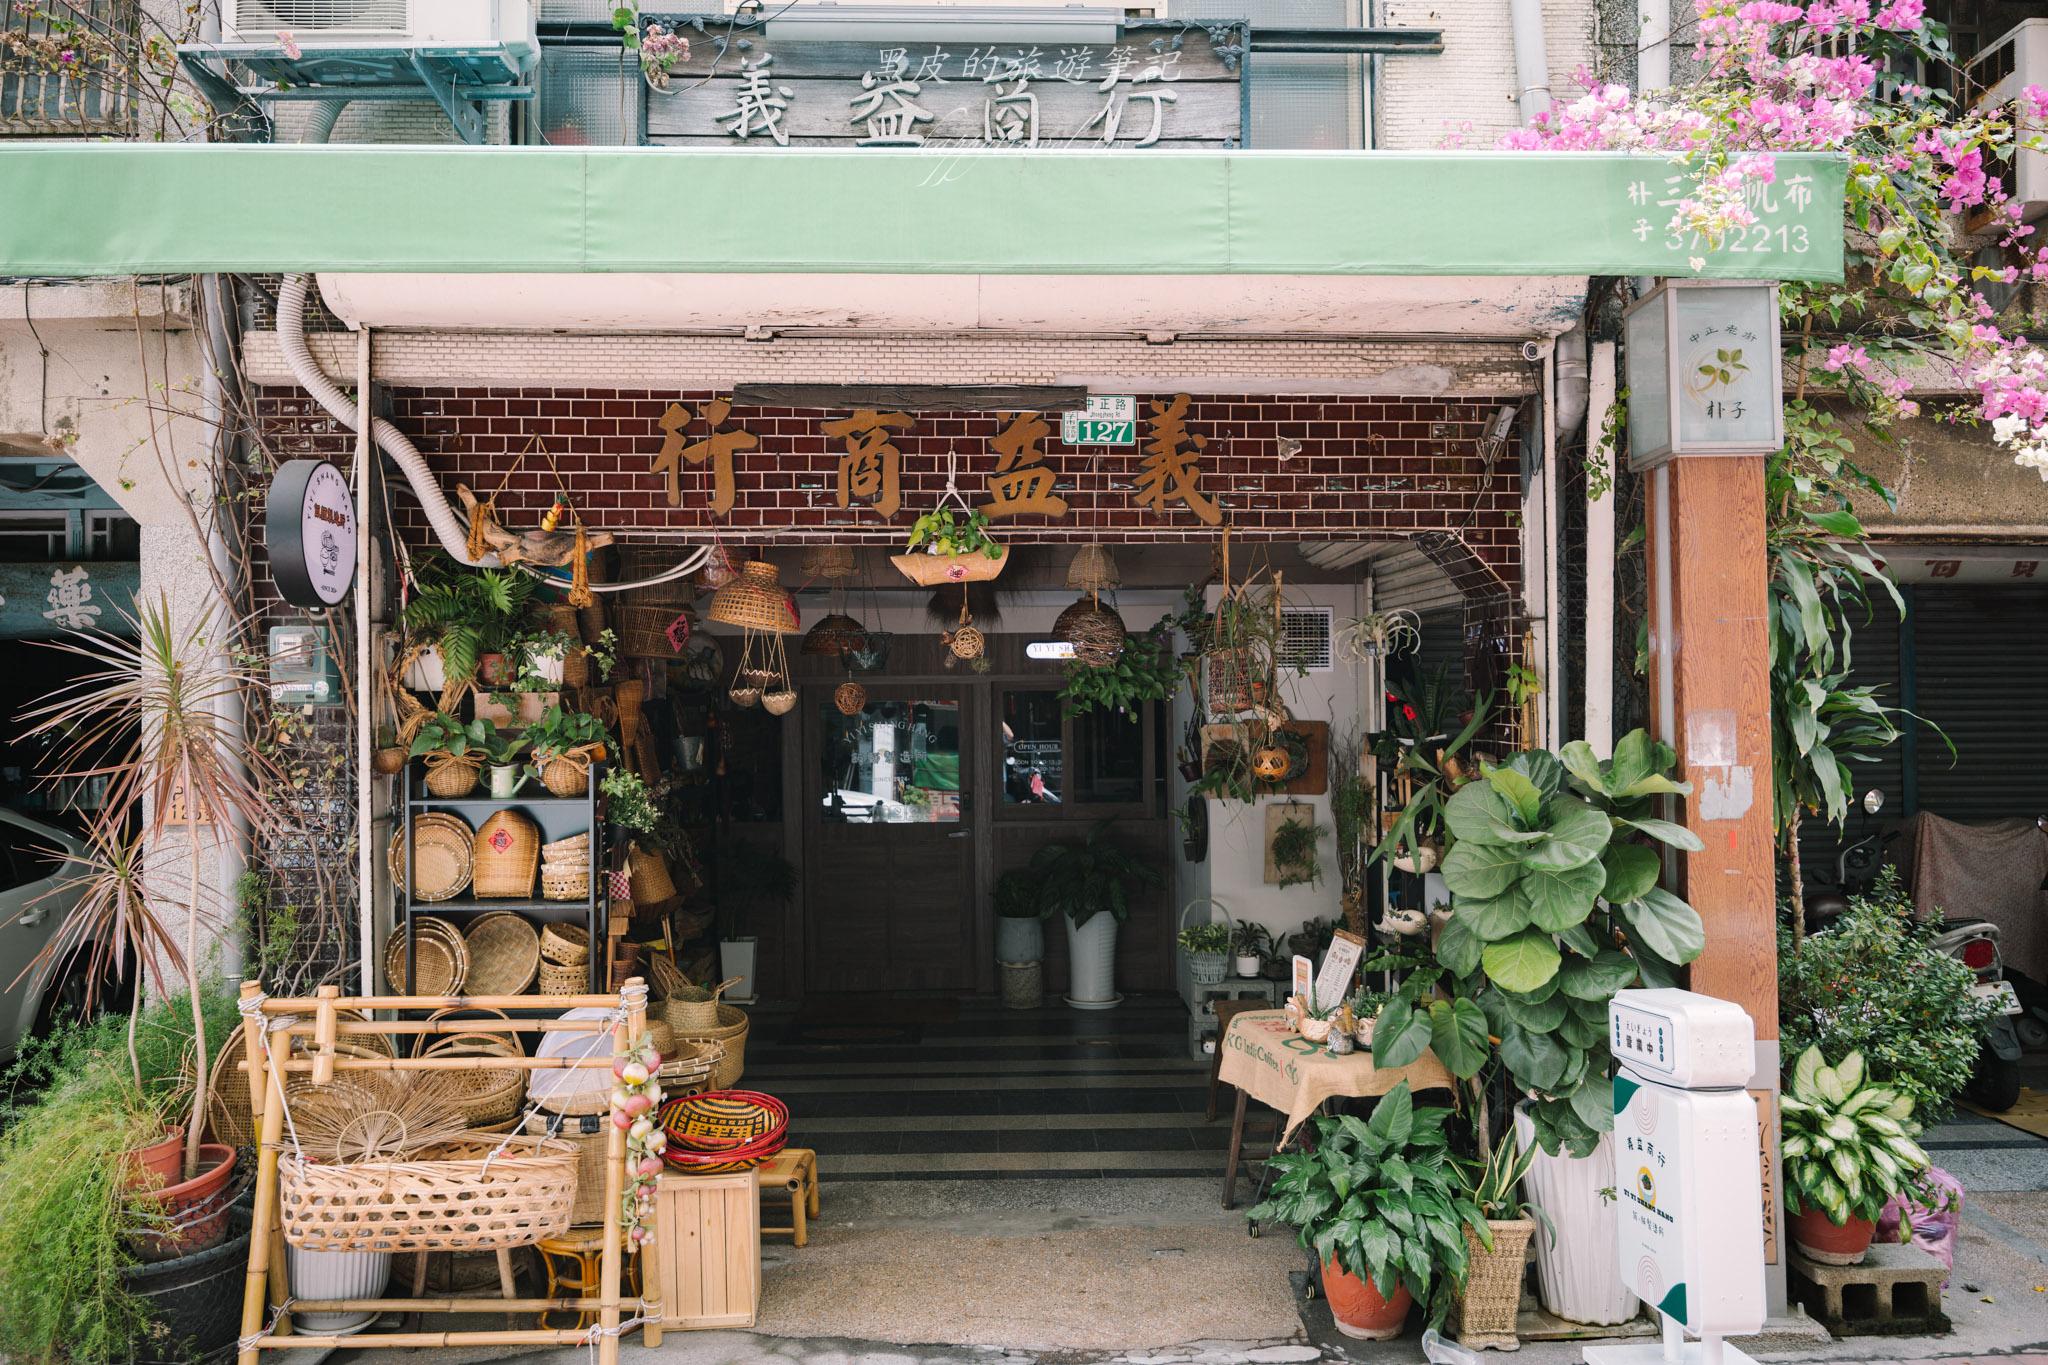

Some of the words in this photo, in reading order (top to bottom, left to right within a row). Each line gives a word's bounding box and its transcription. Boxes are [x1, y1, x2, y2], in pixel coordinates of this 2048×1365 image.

[1656, 173, 1813, 214] 三帆布
[1706, 400, 1747, 420] 朴子
[1082, 421, 1129, 442] 127
